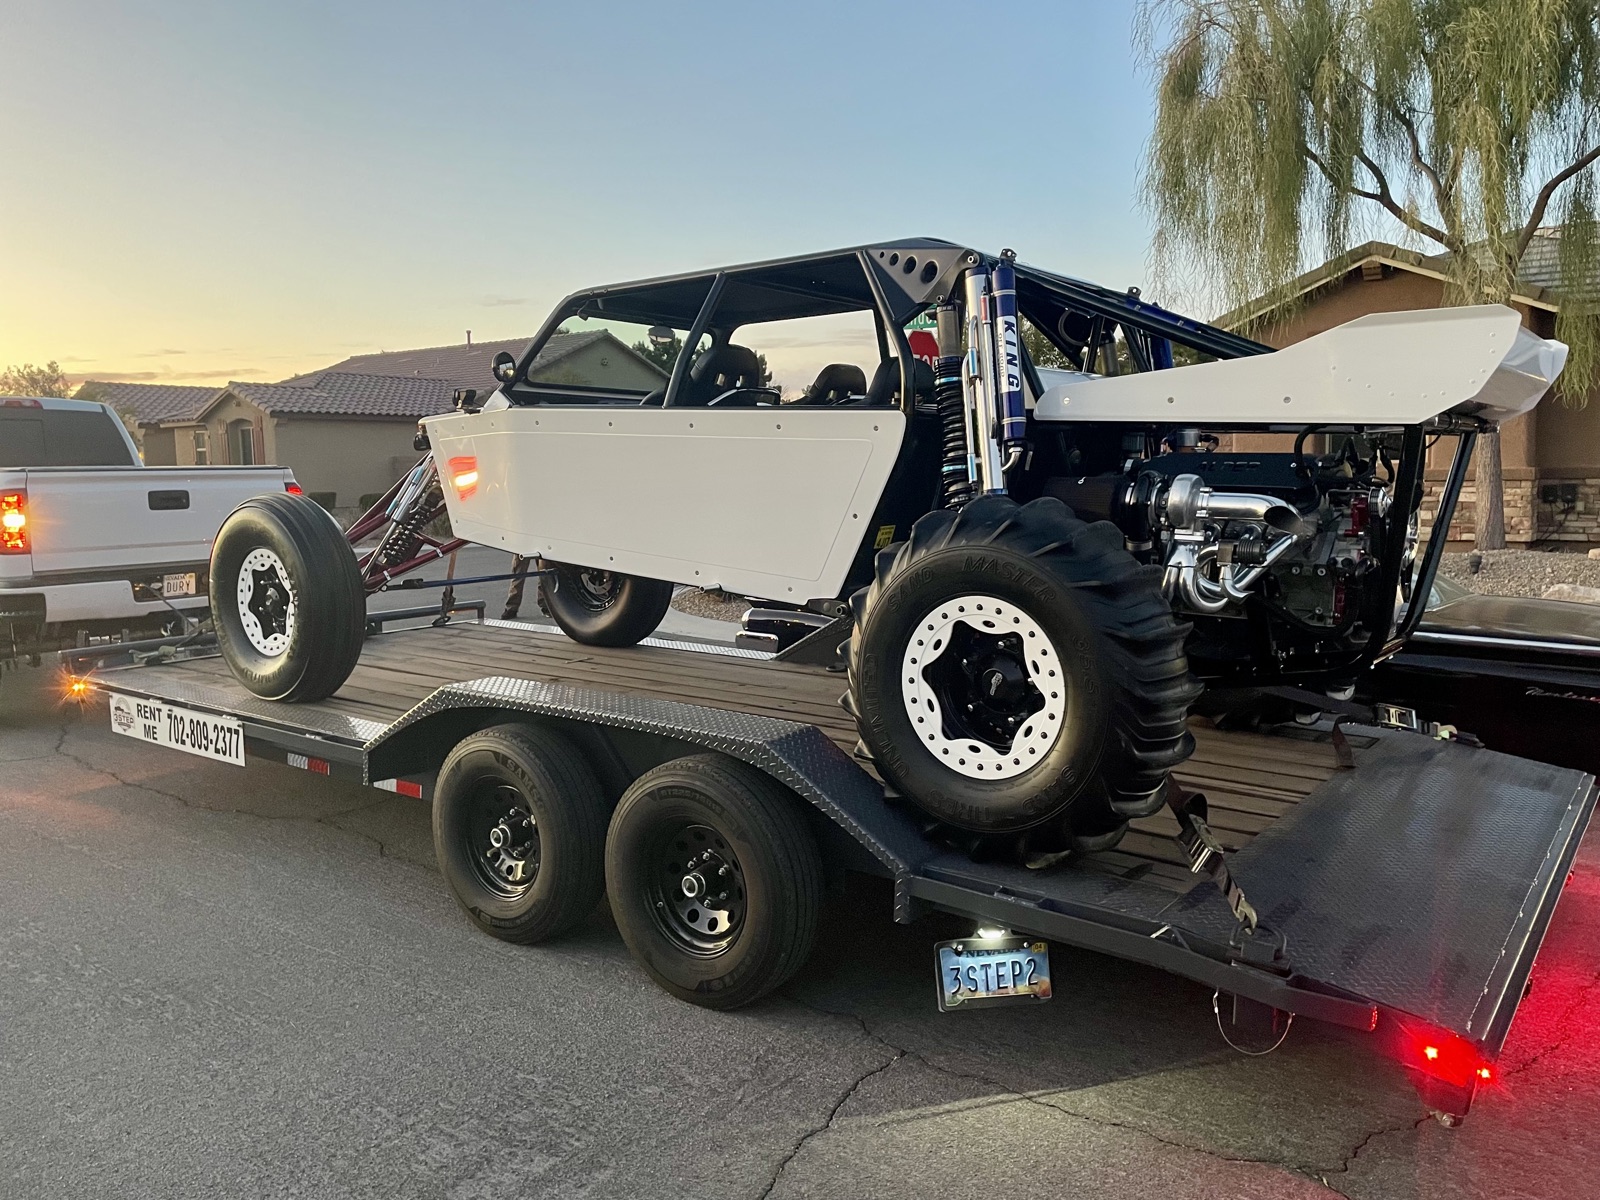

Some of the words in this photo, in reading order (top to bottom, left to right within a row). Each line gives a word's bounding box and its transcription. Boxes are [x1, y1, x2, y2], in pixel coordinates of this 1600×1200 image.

[1004, 320, 1020, 389] KING
[166, 580, 190, 593] DURY
[888, 566, 933, 614] SAND
[961, 555, 1057, 601] MASTER
[136, 703, 162, 723] RENT
[143, 723, 158, 740] ME
[167, 712, 240, 759] 702-809-2377
[949, 956, 1038, 995] 3STEP2
